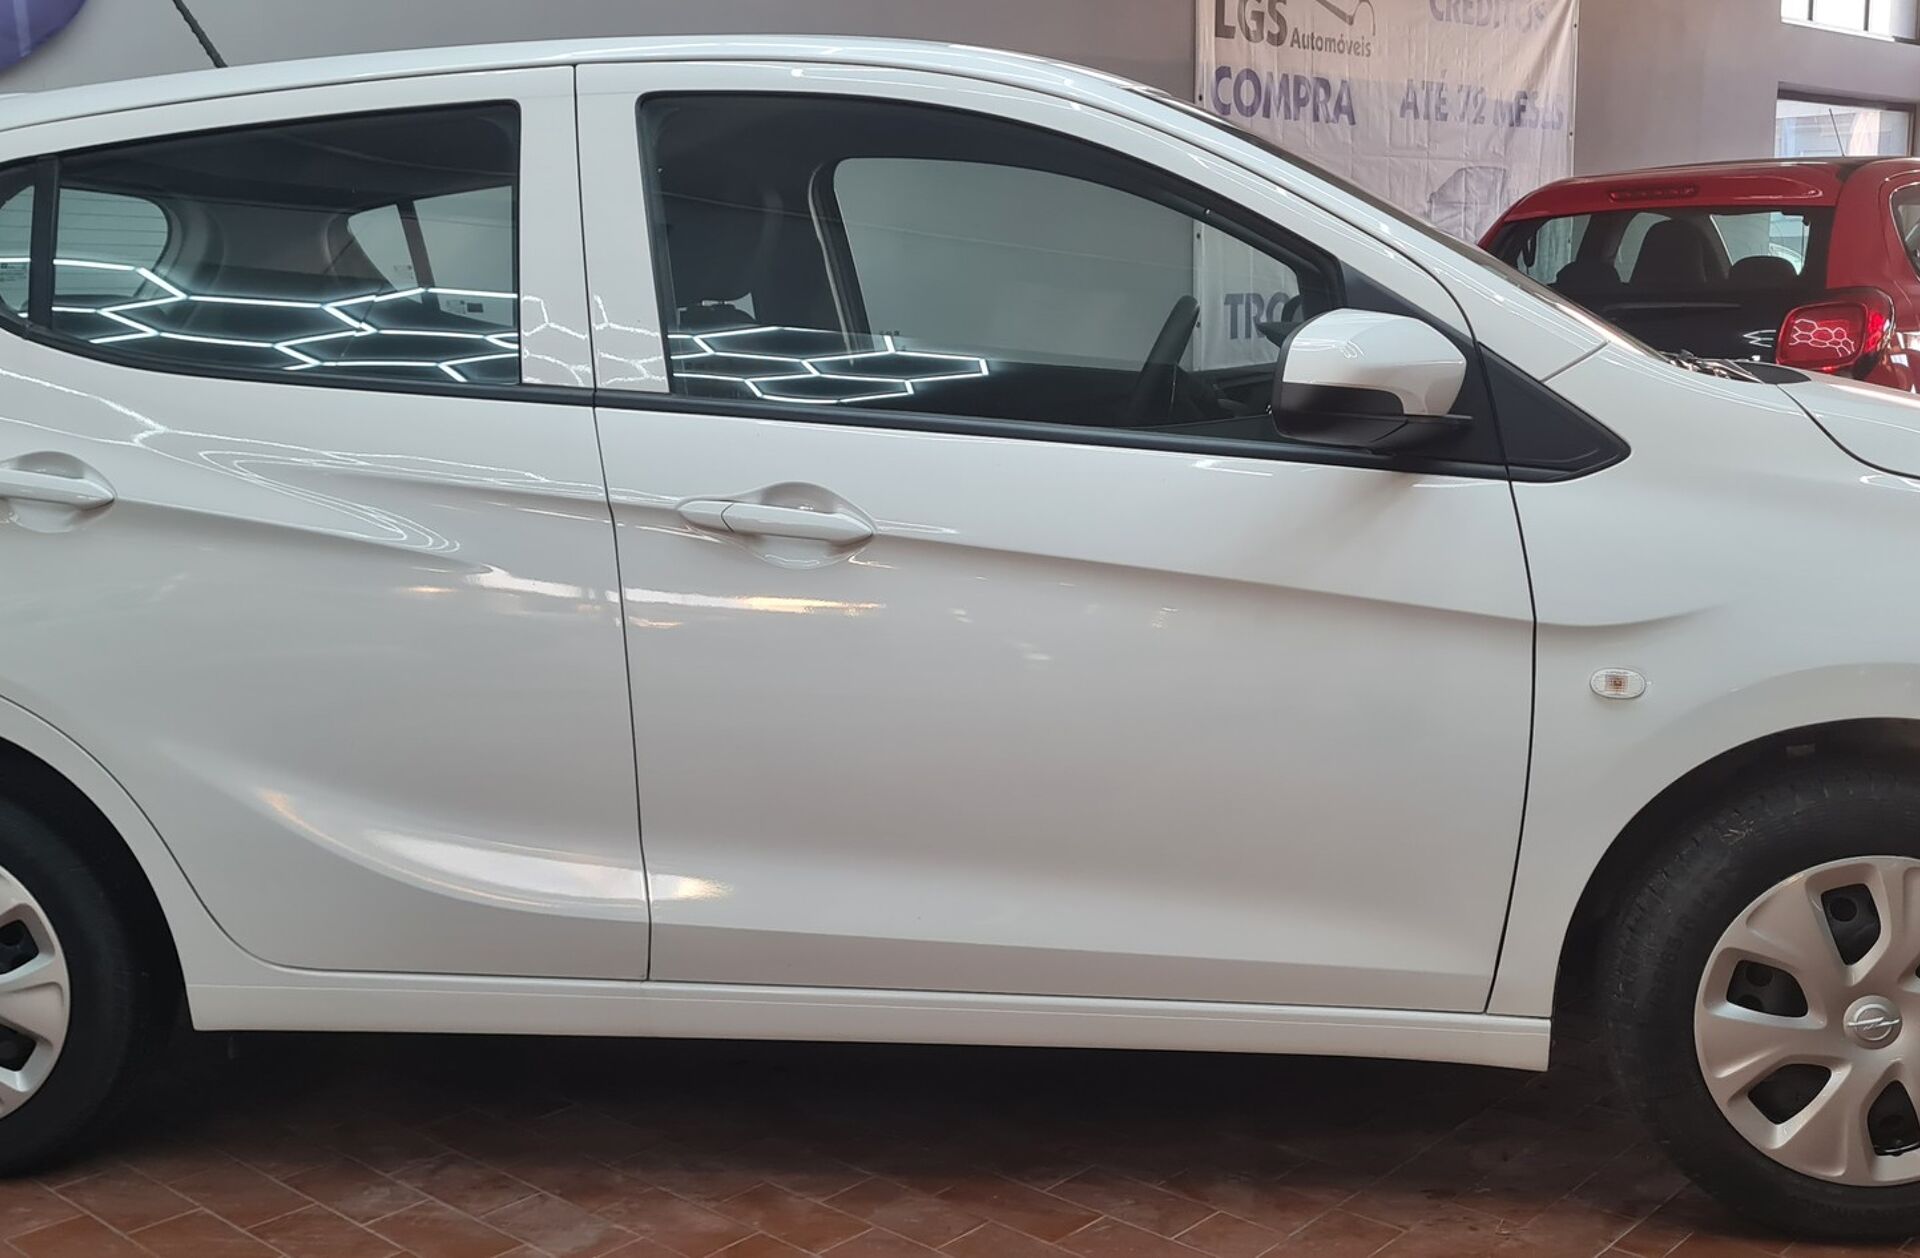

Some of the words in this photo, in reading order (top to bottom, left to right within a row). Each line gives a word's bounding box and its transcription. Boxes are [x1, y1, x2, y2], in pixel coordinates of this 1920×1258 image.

[1215, 0, 1288, 46] LGS
[1290, 27, 1372, 57] Automóveis
[1212, 65, 1356, 126] COMPRA
[1400, 69, 1449, 122] ATÉ
[1457, 83, 1486, 125] 72
